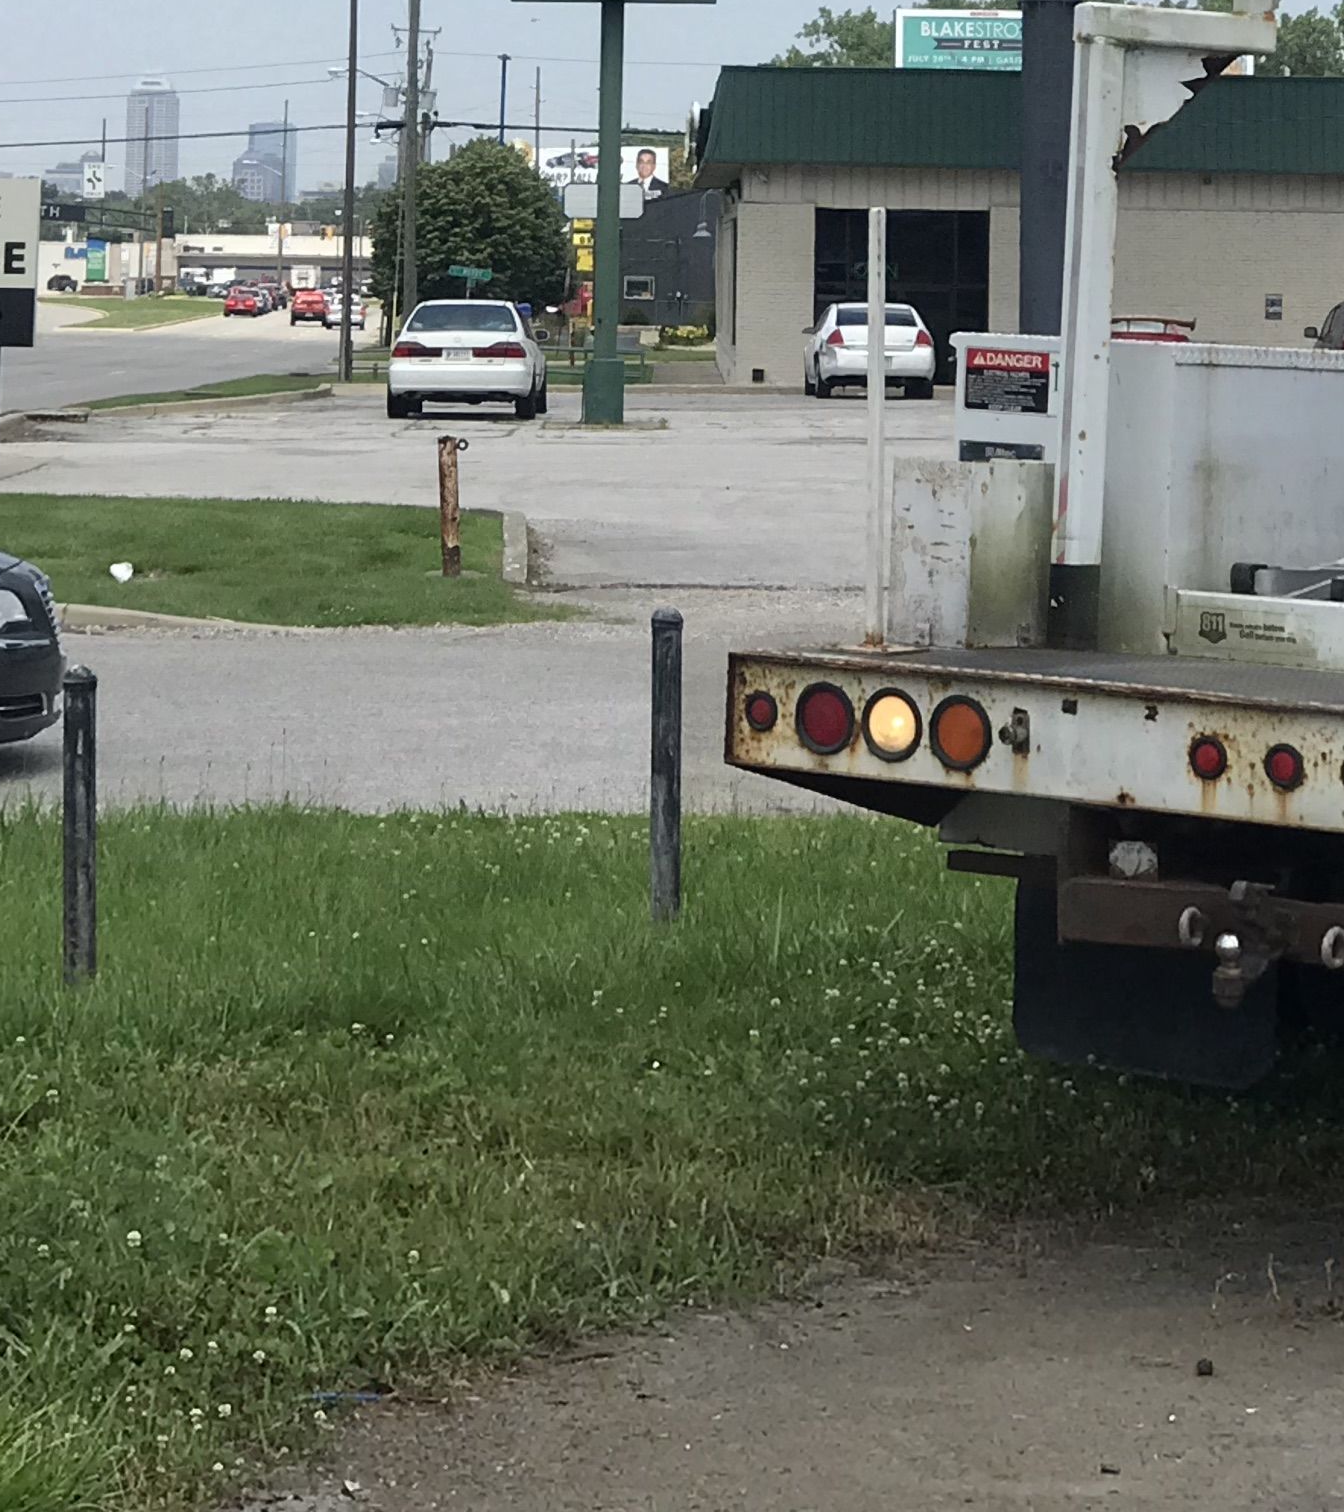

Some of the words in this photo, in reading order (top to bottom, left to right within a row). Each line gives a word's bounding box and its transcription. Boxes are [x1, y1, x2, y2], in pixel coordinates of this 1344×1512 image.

[963, 39, 1000, 49] FEST
[986, 352, 1042, 369] DANGER
[1201, 613, 1224, 632] 811
